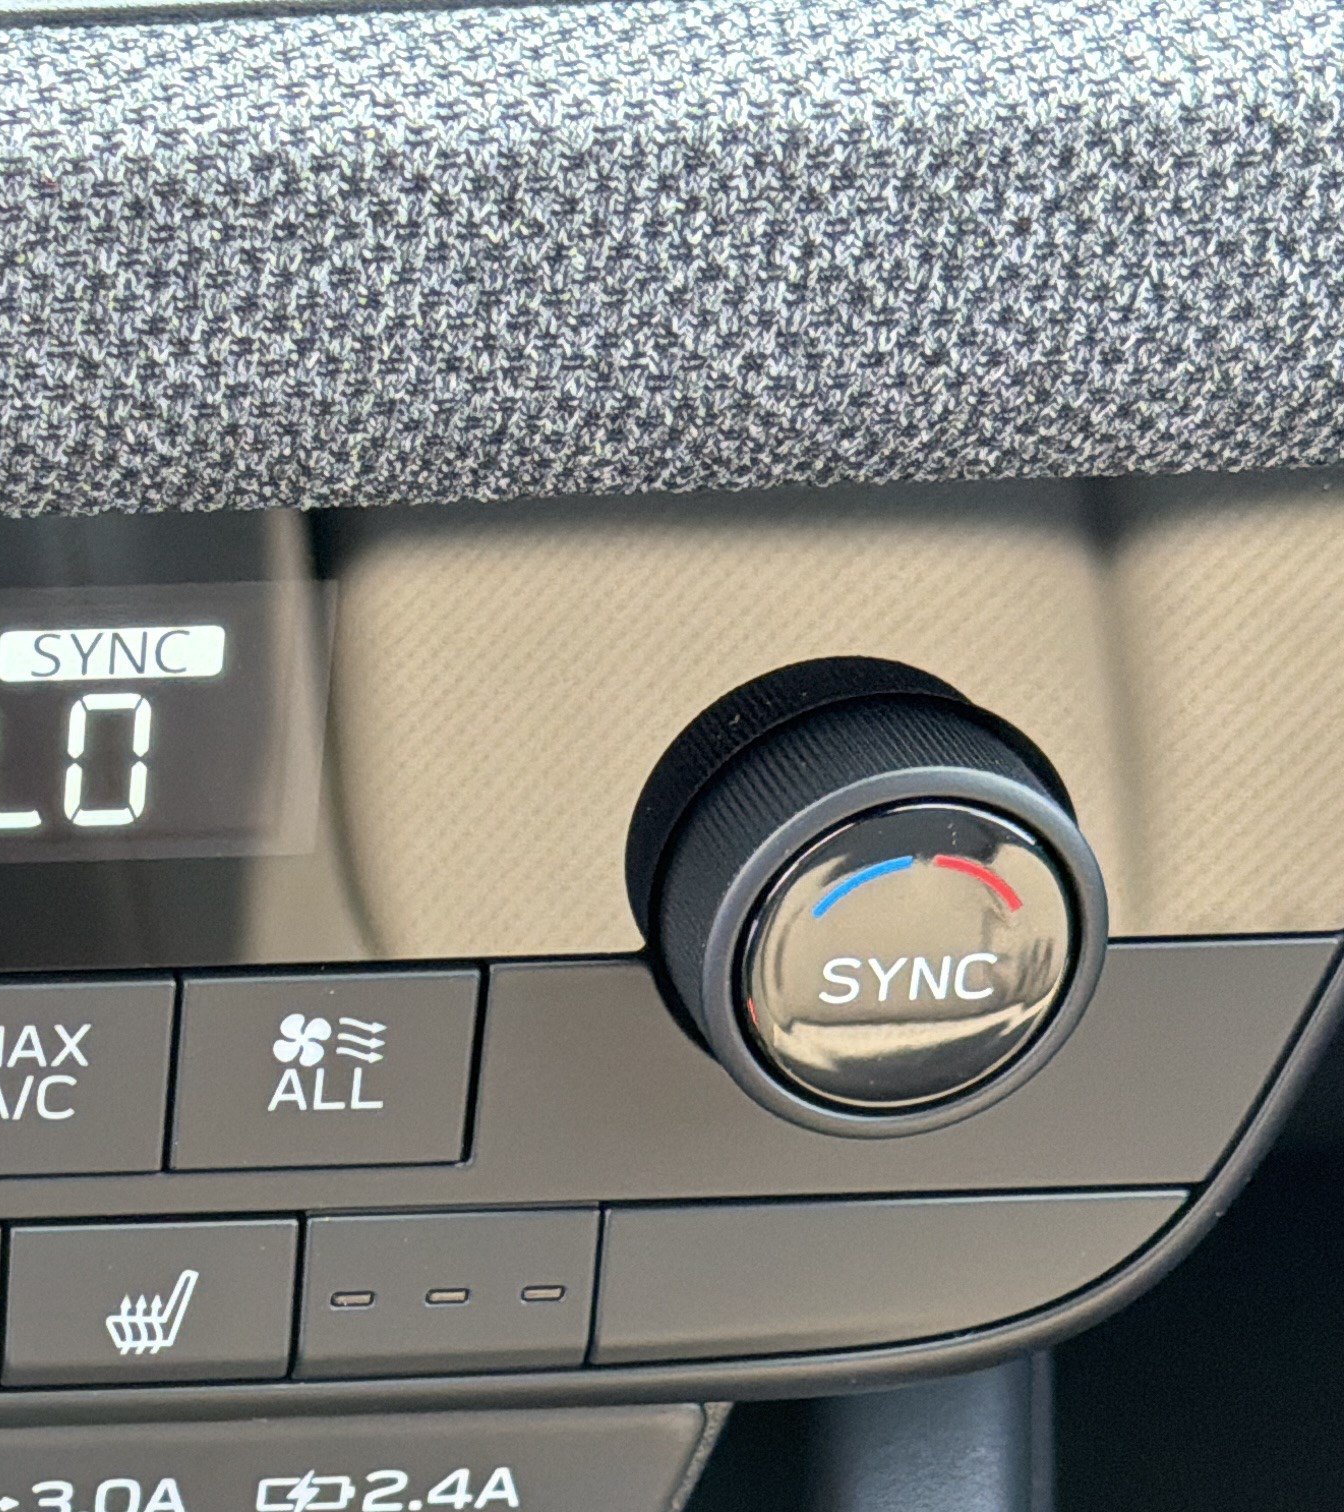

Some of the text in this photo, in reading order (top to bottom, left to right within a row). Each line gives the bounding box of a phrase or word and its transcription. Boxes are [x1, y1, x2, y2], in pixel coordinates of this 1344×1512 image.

[30, 629, 191, 680] SYNC
[818, 952, 998, 1004] SYNC
[267, 1068, 384, 1112] ALL
[361, 1466, 520, 1512] 2.4A
